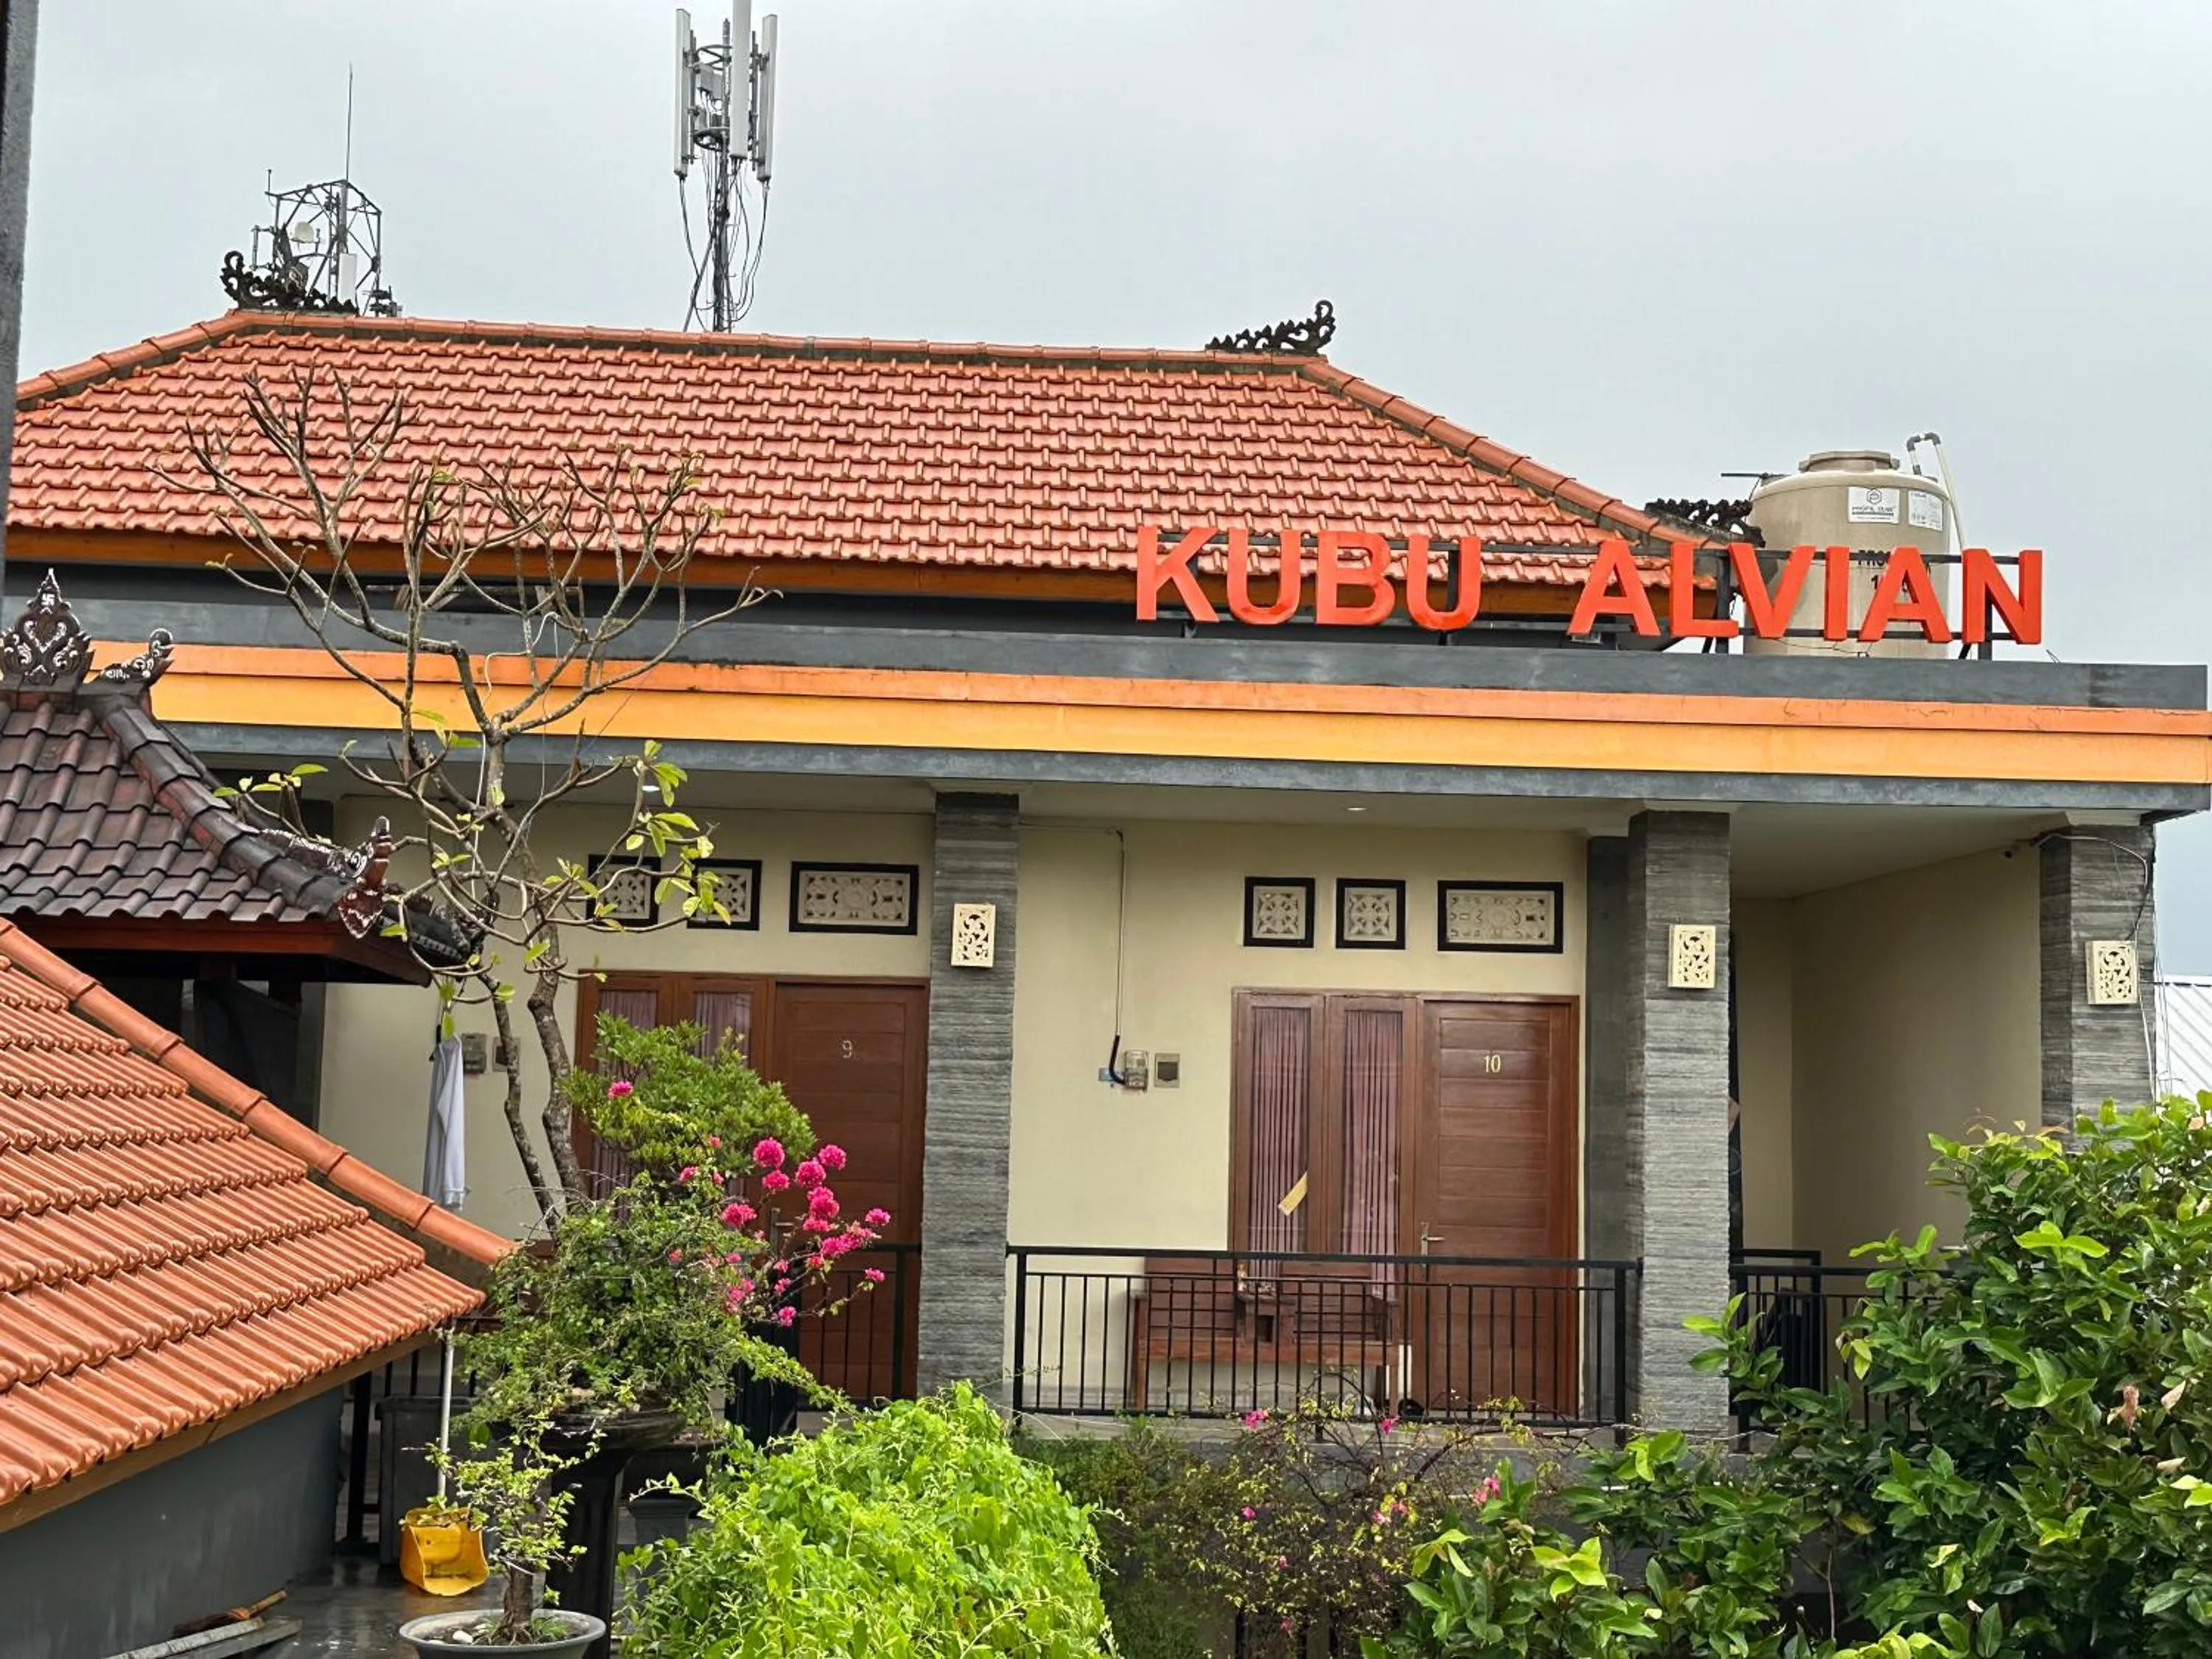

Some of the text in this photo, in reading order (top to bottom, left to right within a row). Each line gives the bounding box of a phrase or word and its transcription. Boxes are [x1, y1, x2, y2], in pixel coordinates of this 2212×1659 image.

[1136, 526, 2043, 644] KUBU ALVIAN
[842, 1040, 852, 1059] 9
[1484, 1054, 1501, 1074] 10
